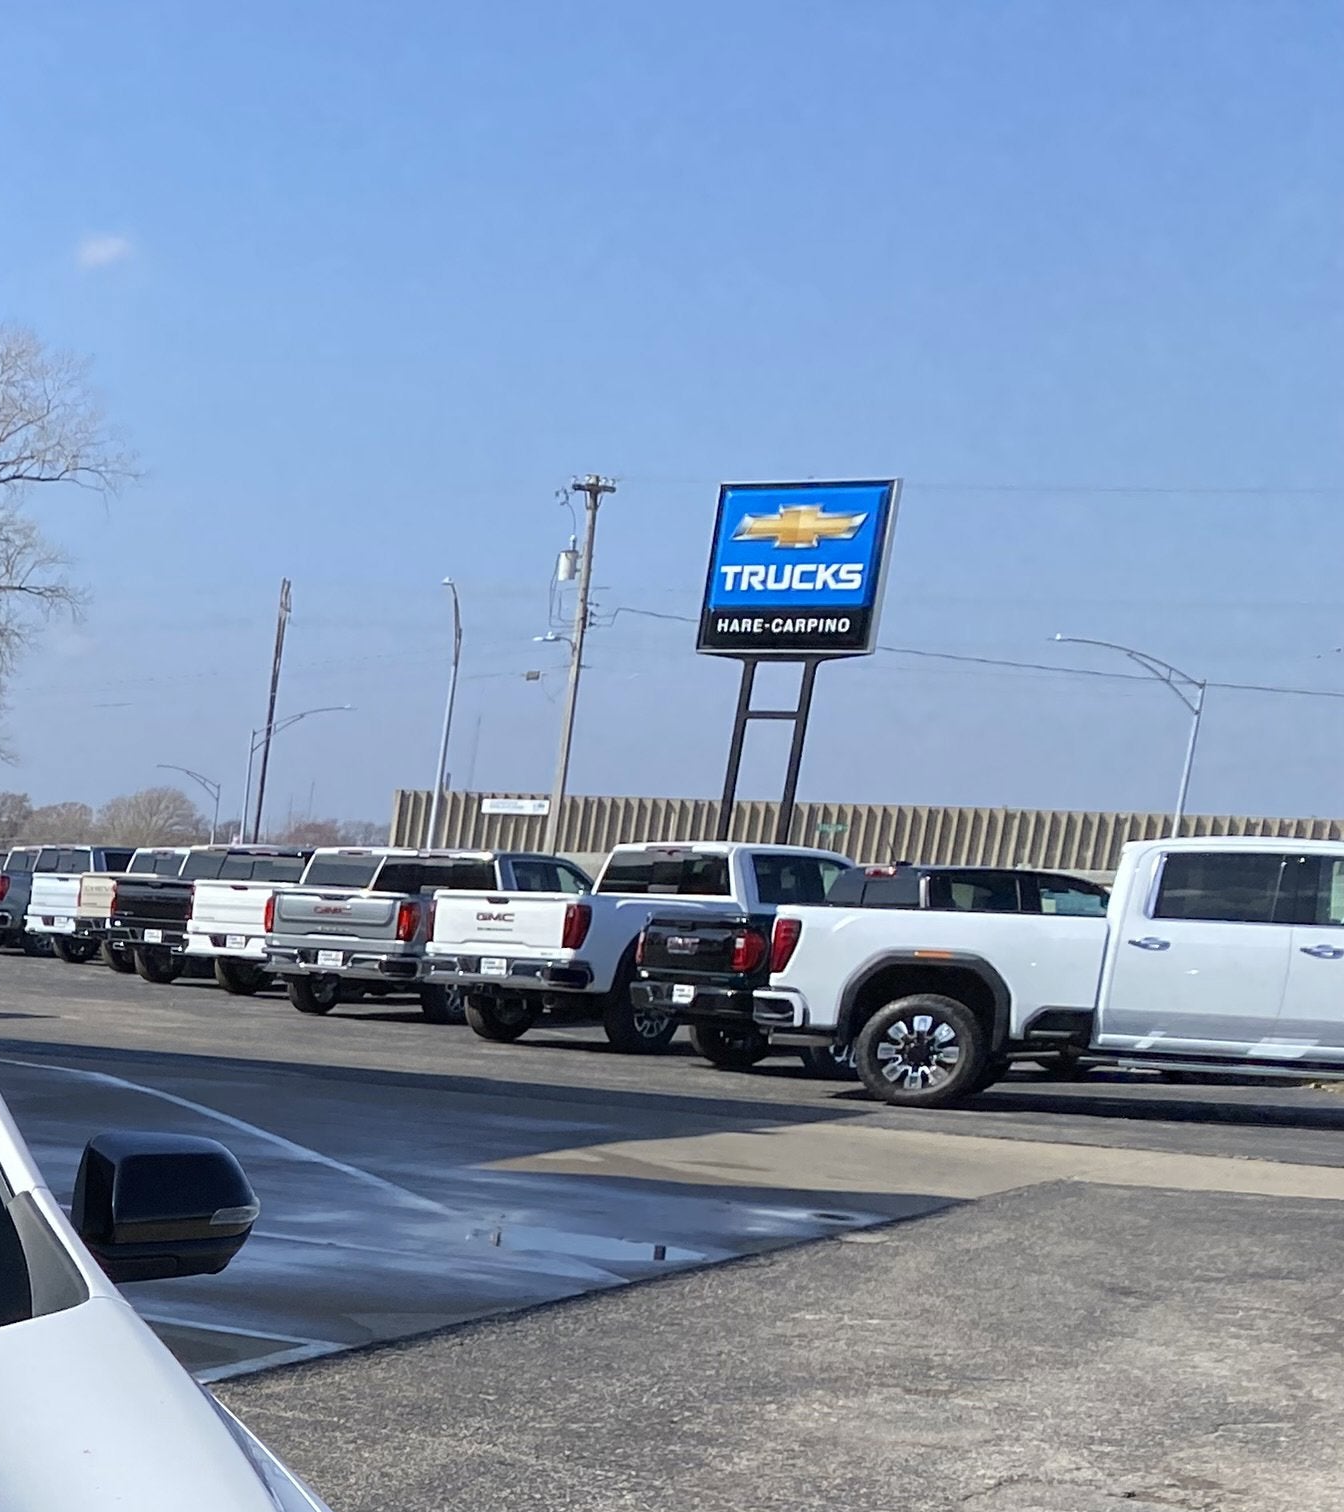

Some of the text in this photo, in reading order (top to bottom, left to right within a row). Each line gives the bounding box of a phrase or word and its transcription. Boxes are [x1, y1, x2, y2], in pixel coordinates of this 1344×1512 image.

[720, 563, 864, 591] TRUCKS
[717, 617, 851, 633] HARE-CARPINO
[476, 912, 515, 922] GMC
